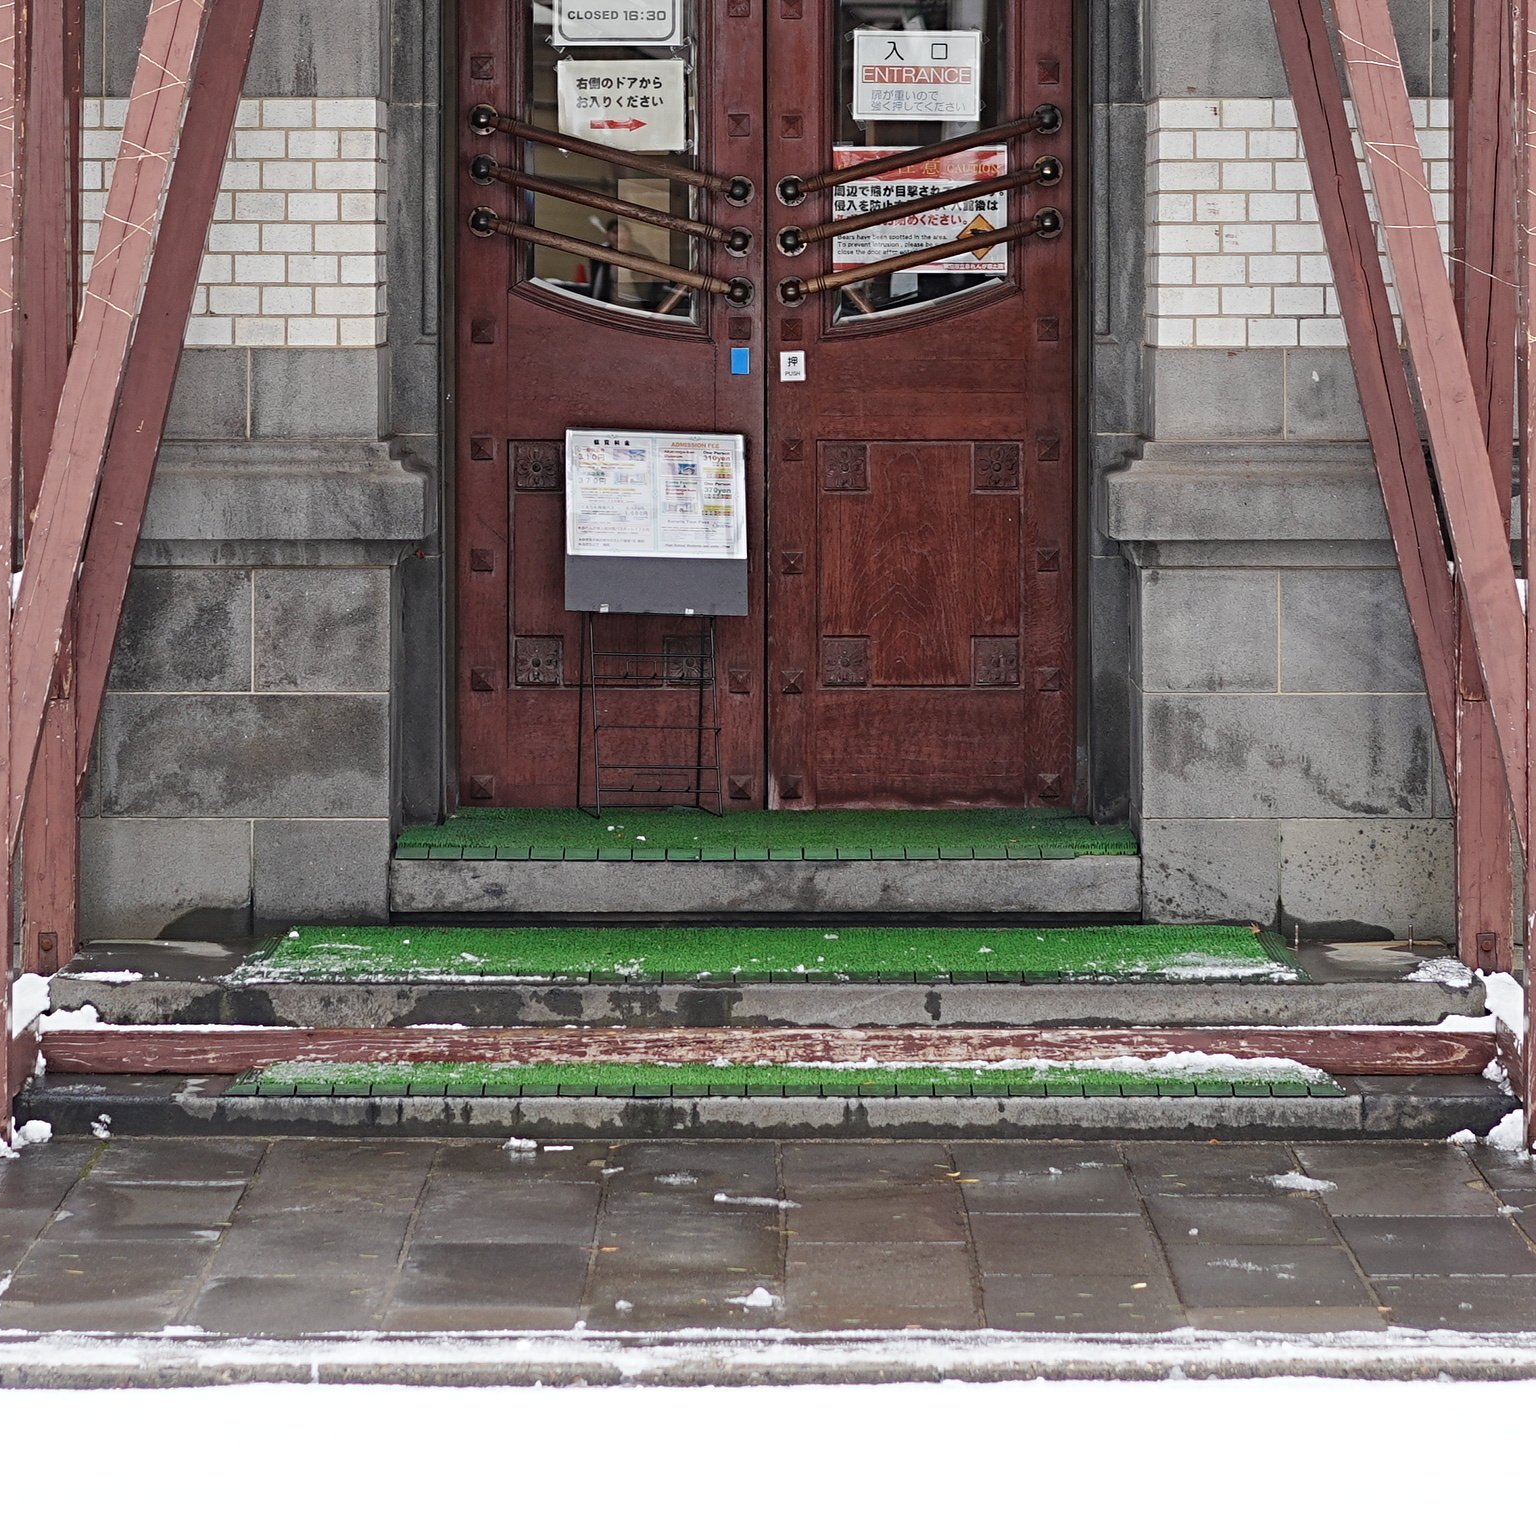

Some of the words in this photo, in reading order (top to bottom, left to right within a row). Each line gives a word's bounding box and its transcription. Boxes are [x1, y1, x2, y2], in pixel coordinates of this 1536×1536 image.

[567, 10, 619, 20] CLOSED
[624, 10, 667, 21] 16:30
[884, 41, 948, 61] 入口
[863, 66, 972, 83] ENTRANCE
[576, 76, 663, 90] 右側のドアから
[871, 89, 939, 101] 扉が重いので
[576, 95, 664, 109] お入りください
[871, 101, 966, 112] 強く押してください
[946, 164, 1000, 174] CAUTION
